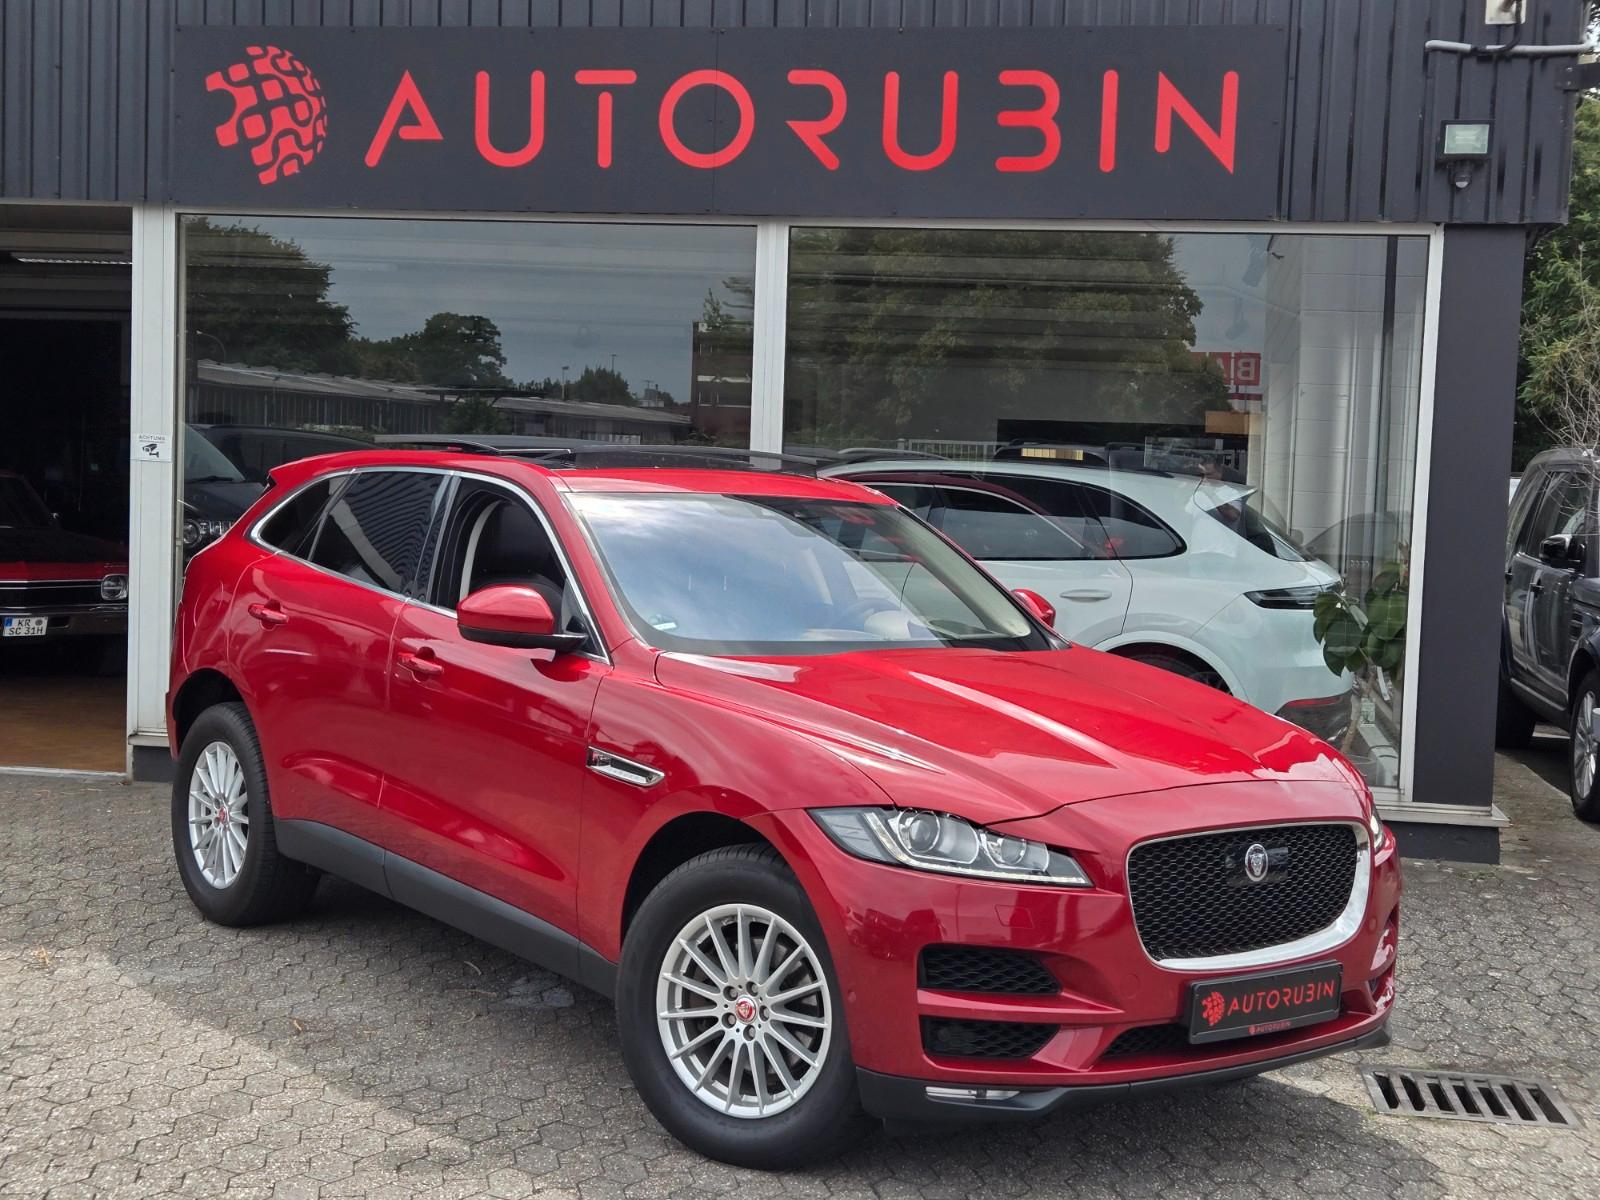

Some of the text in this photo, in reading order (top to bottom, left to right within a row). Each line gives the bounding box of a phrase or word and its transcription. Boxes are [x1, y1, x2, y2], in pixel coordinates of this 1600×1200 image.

[364, 68, 1240, 174] AUTORUBIN
[9, 626, 44, 635] SC 31H
[18, 618, 31, 627] KR
[1227, 979, 1335, 1016] AUTORUBIN
